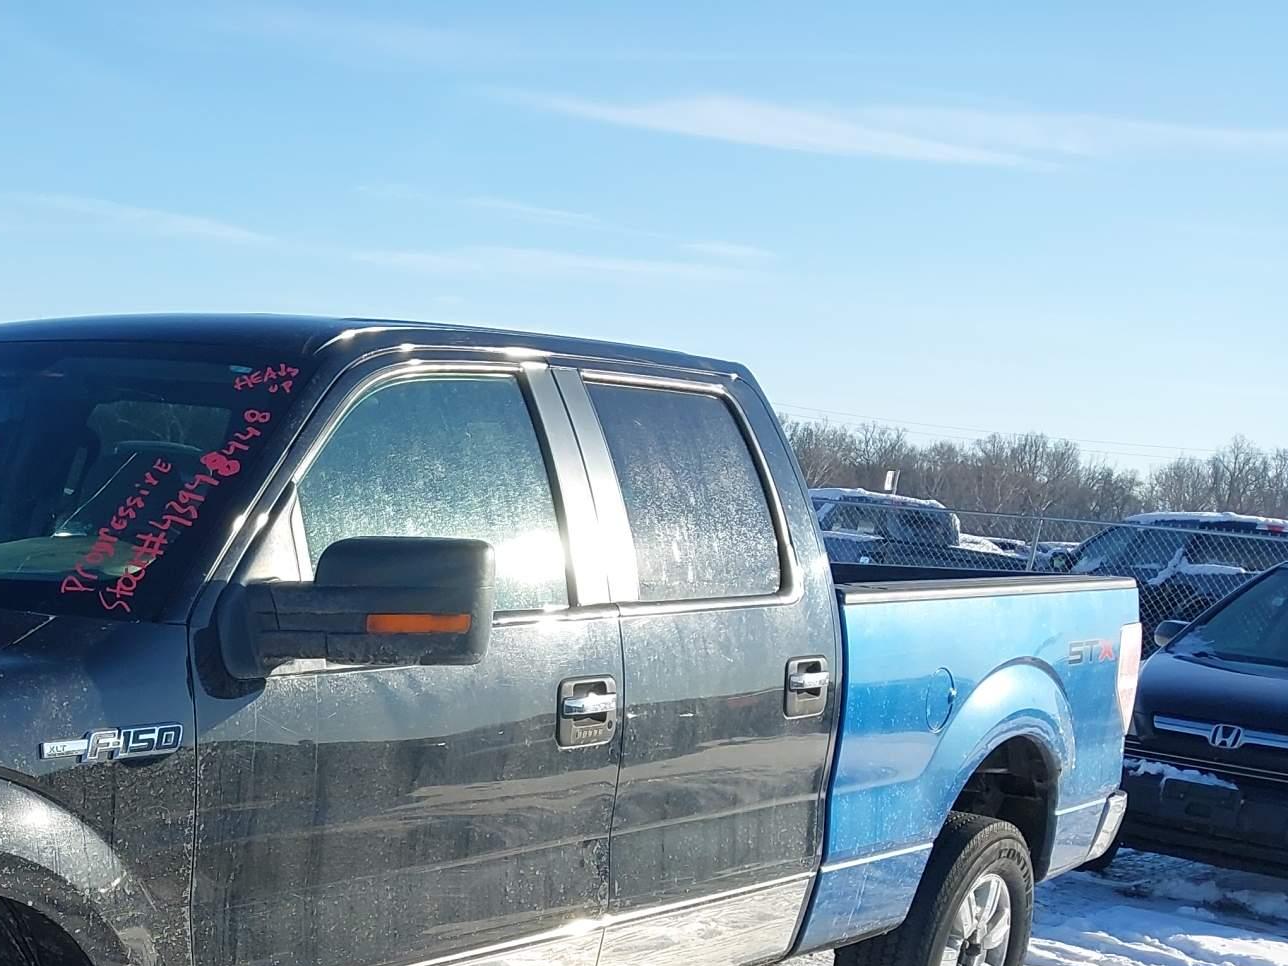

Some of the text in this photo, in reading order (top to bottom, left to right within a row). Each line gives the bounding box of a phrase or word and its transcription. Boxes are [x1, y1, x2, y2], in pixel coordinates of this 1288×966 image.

[1067, 638, 1116, 666] STX
[48, 723, 184, 760] XLT F-150
